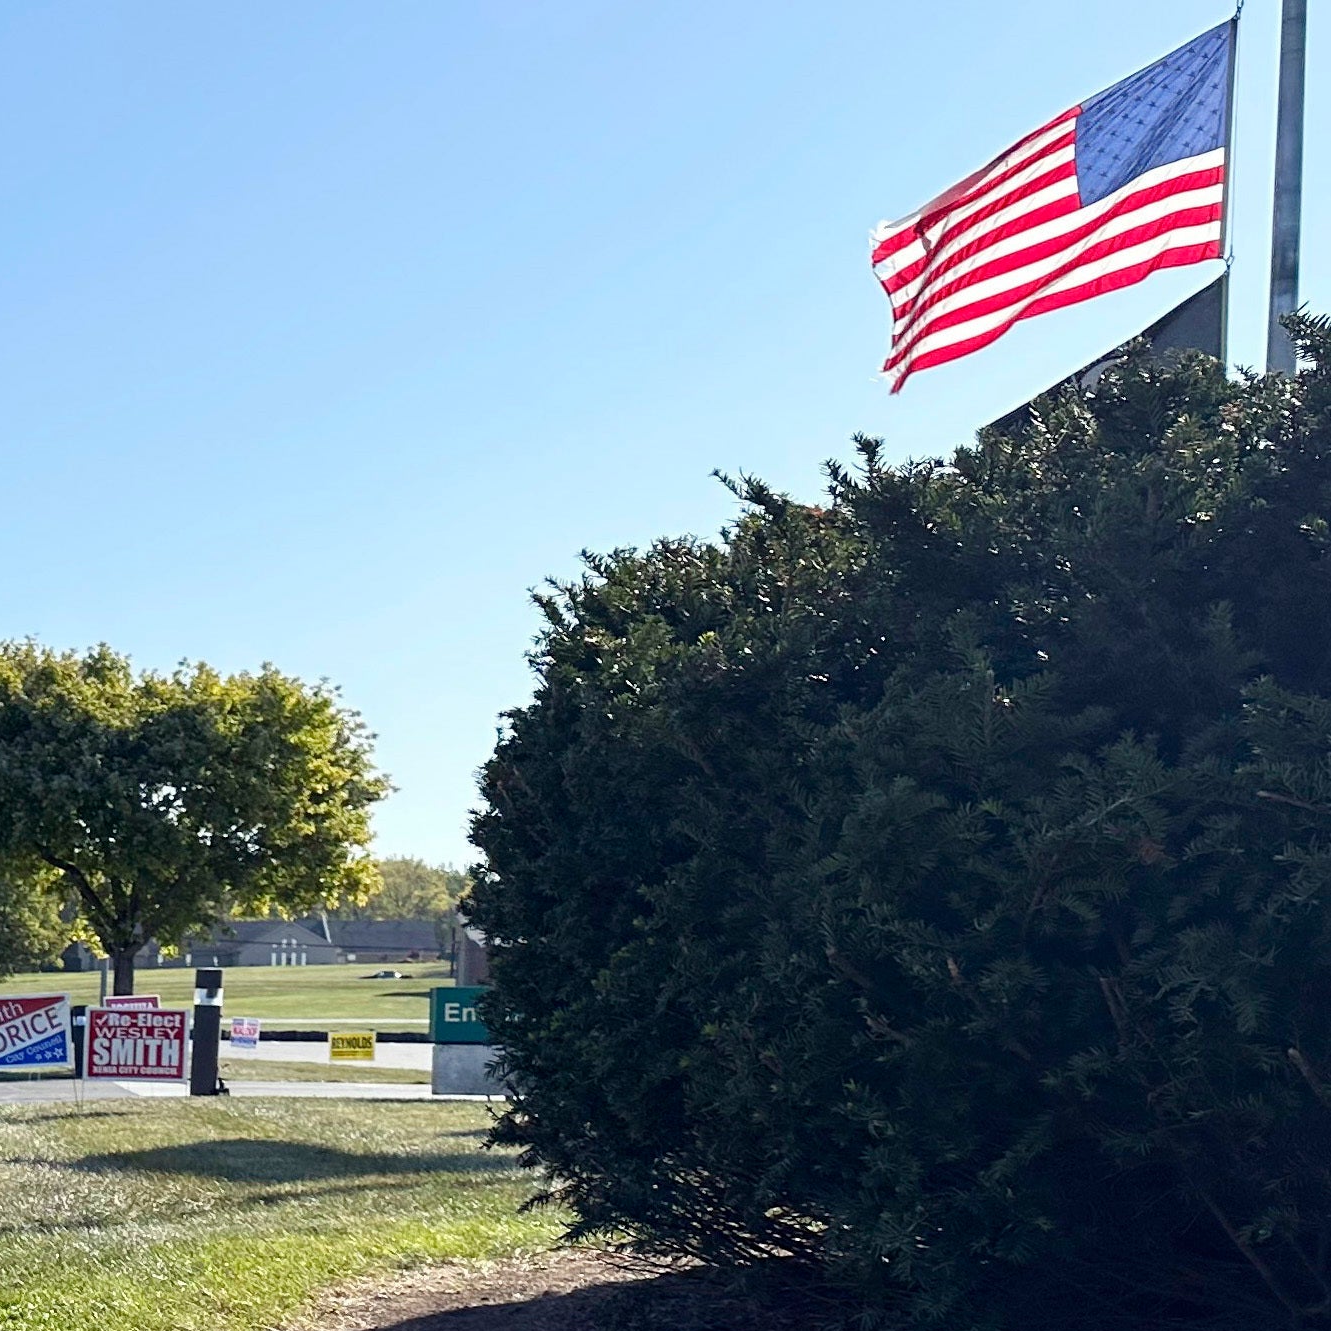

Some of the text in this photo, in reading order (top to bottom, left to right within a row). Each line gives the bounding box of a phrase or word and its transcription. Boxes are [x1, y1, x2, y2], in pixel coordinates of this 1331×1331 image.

[108, 1012, 181, 1028] Re-Elect
[95, 1027, 179, 1039] WESLEY
[332, 1036, 372, 1049] REYNOLDS
[92, 1038, 180, 1067] SMITH
[119, 1066, 140, 1074] CITY
[141, 1066, 178, 1075] COUNCIL
